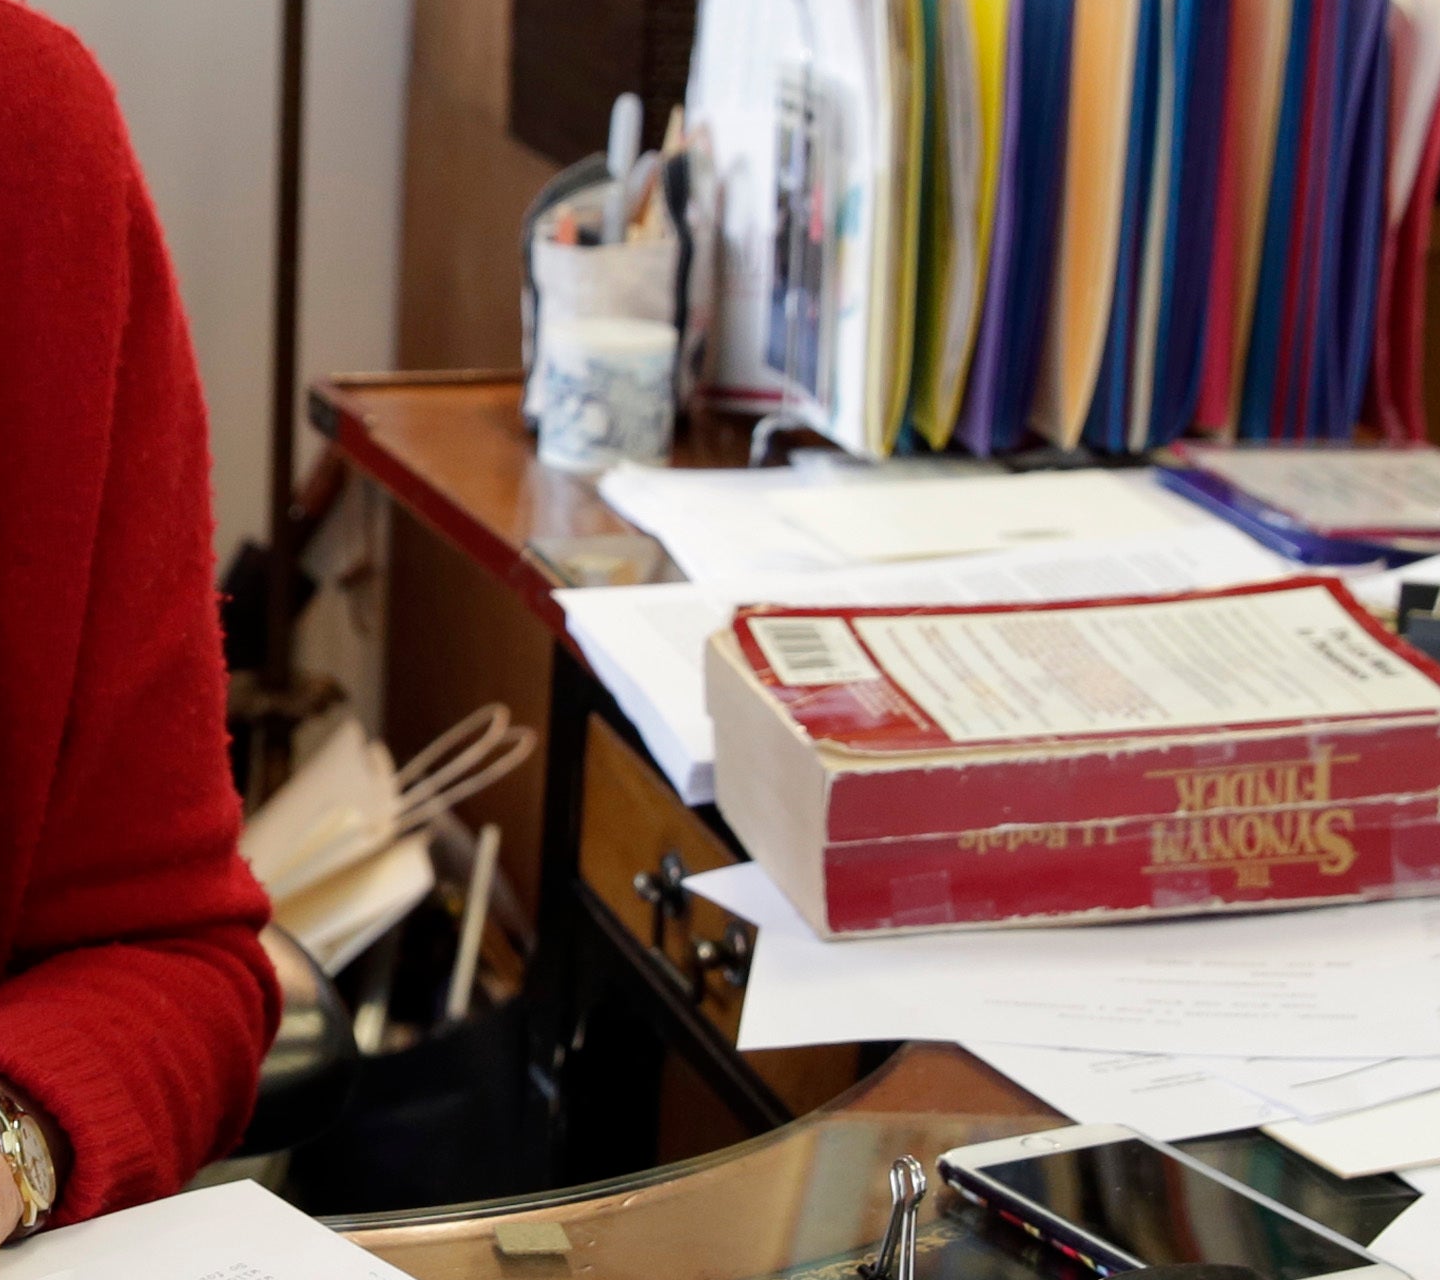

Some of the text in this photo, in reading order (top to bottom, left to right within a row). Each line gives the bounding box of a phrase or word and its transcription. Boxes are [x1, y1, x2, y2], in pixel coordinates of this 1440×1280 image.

[1173, 744, 1333, 814] FINDER
[957, 826, 1067, 854] Rodale
[1151, 808, 1358, 876] SYNONYM
